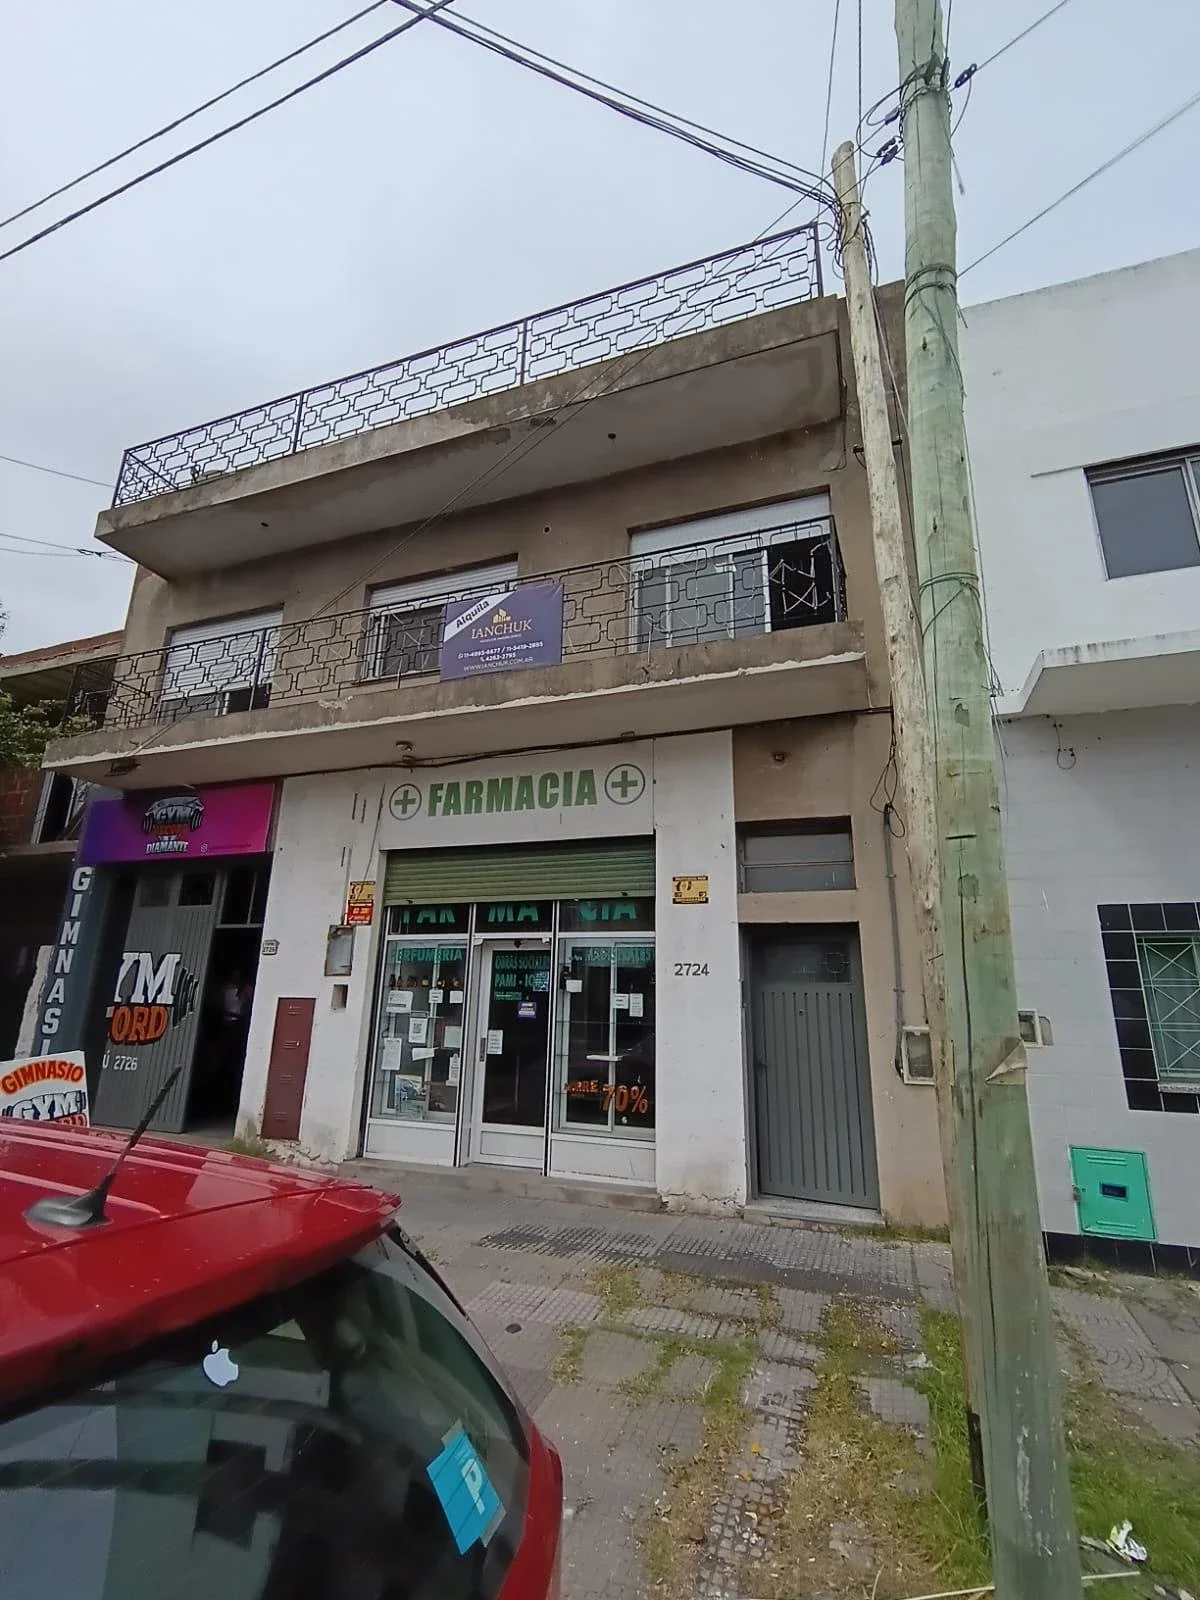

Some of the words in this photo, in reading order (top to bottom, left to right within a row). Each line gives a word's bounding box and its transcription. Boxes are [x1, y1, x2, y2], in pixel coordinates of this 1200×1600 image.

[456, 600, 490, 629] Alquila
[427, 769, 598, 817] FARMACIA
[146, 841, 189, 854] DIAMANTE
[674, 963, 710, 976] 2724
[0, 1060, 84, 1095] GIMNASIO
[113, 1055, 139, 1071] 2726
[12, 1090, 82, 1121] GYM
[601, 1083, 649, 1114] 70%
